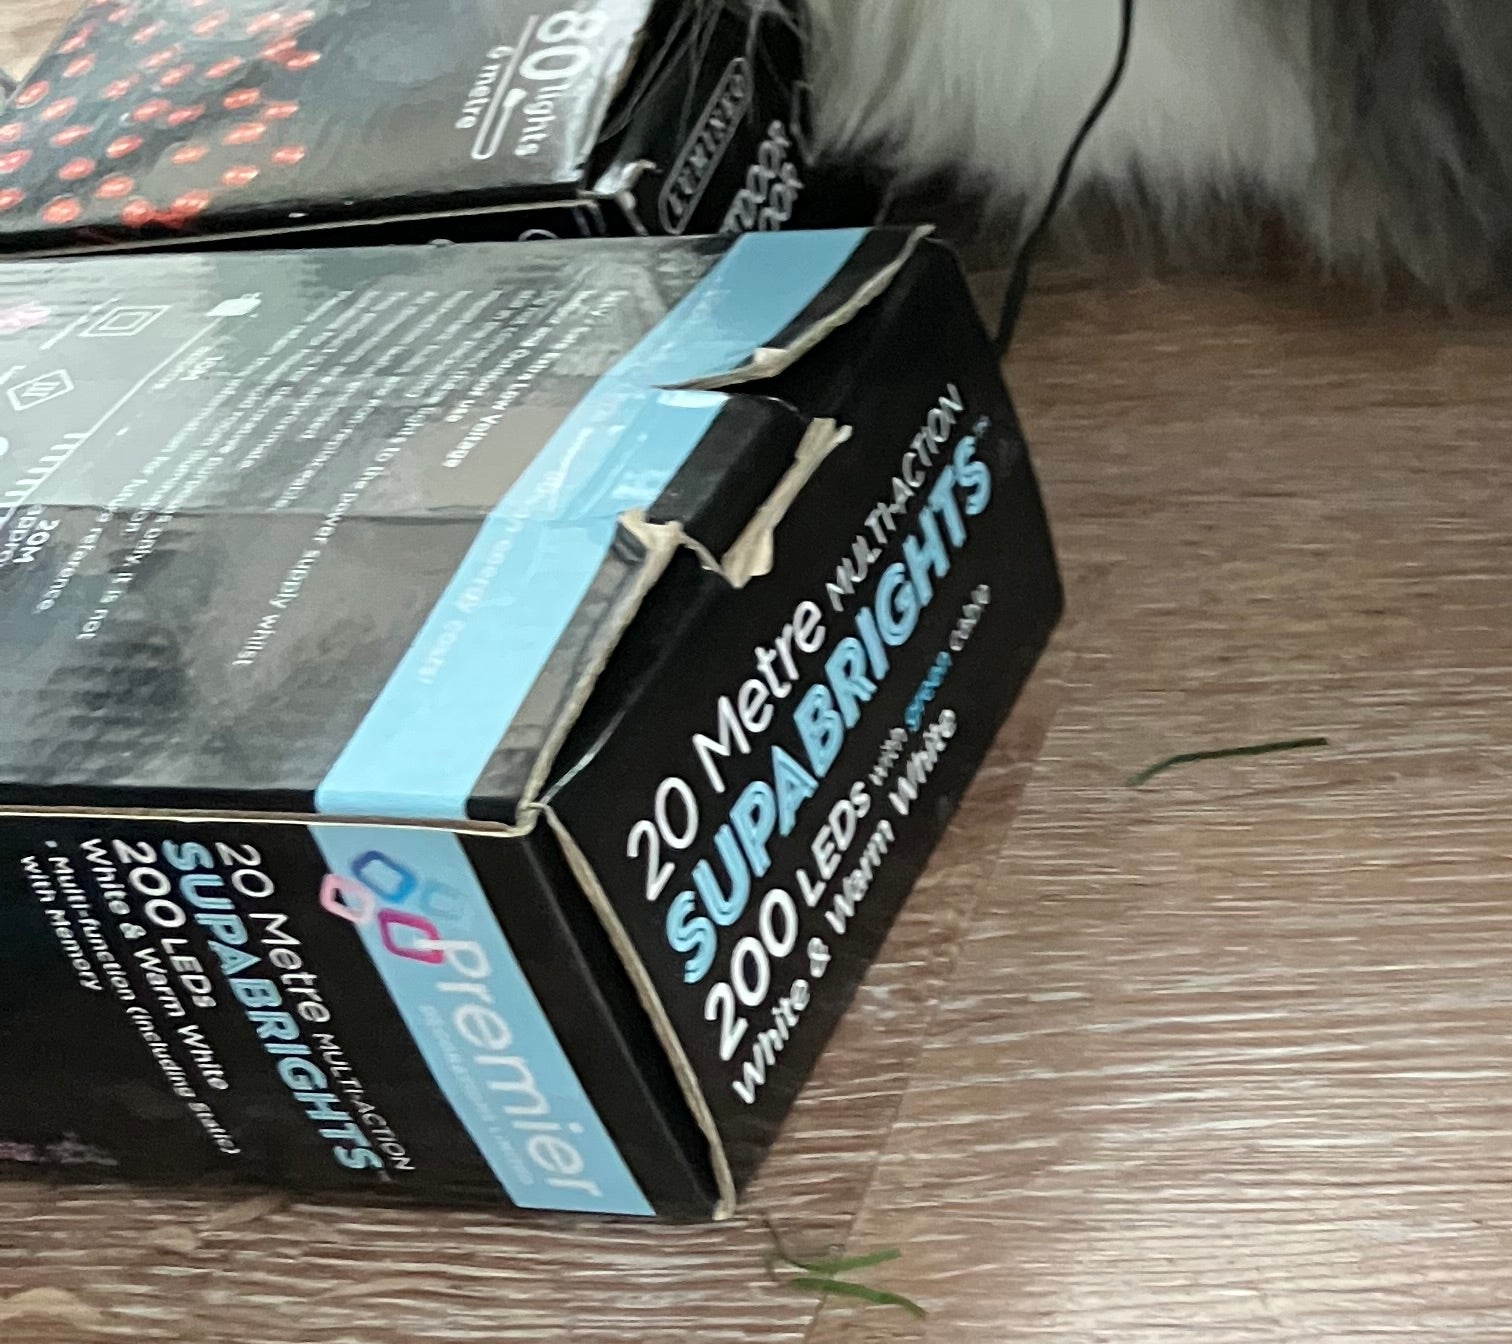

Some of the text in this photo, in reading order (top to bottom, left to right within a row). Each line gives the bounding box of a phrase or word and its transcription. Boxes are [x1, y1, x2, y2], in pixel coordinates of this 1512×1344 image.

[456, 64, 503, 130] metre
[515, 10, 615, 158] 80 lights
[446, 400, 476, 422] use
[492, 384, 531, 411] Low
[388, 408, 436, 444] lights
[442, 415, 503, 468] Voltage
[354, 467, 386, 490] the
[375, 448, 402, 462] to
[12, 520, 60, 563] 20M
[314, 493, 360, 545] power
[101, 591, 123, 603] is
[113, 573, 134, 584] it
[269, 550, 322, 609] supply
[77, 610, 108, 640] not
[232, 615, 282, 666] whilst
[627, 384, 965, 903] 20 Metre MULTI-ACTION
[113, 840, 188, 929] 200
[733, 710, 957, 1105] White & Warm White
[20, 857, 104, 991] with Memory
[48, 857, 136, 1001] Multi-function
[126, 1007, 196, 1098] (including
[80, 839, 230, 1091] White & Warm White
[705, 889, 799, 1062] 200
[215, 842, 417, 1171] 20 Metre MULTI-ACTION
[413, 940, 606, 1199] Premier
